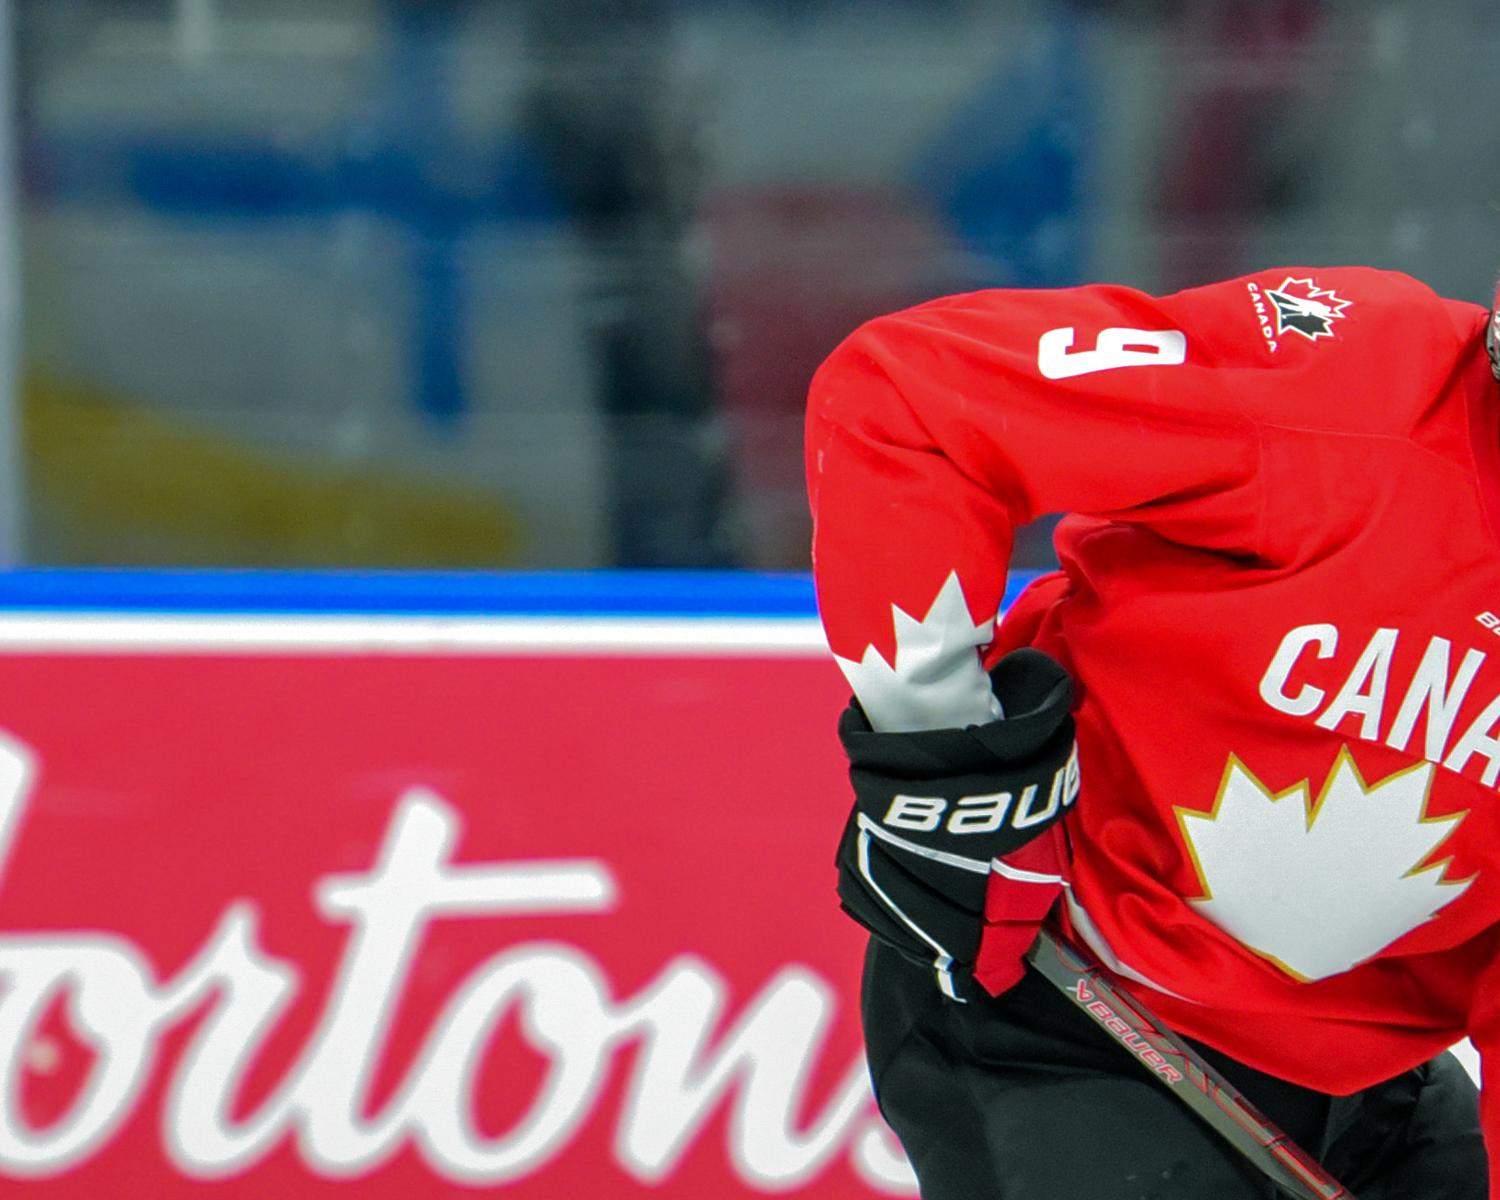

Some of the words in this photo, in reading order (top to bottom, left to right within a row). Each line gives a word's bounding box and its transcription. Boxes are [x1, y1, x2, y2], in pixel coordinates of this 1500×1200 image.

[1038, 327, 1187, 379] 9
[1247, 282, 1278, 354] CANADA
[1086, 1001, 1183, 1085] BAUER
